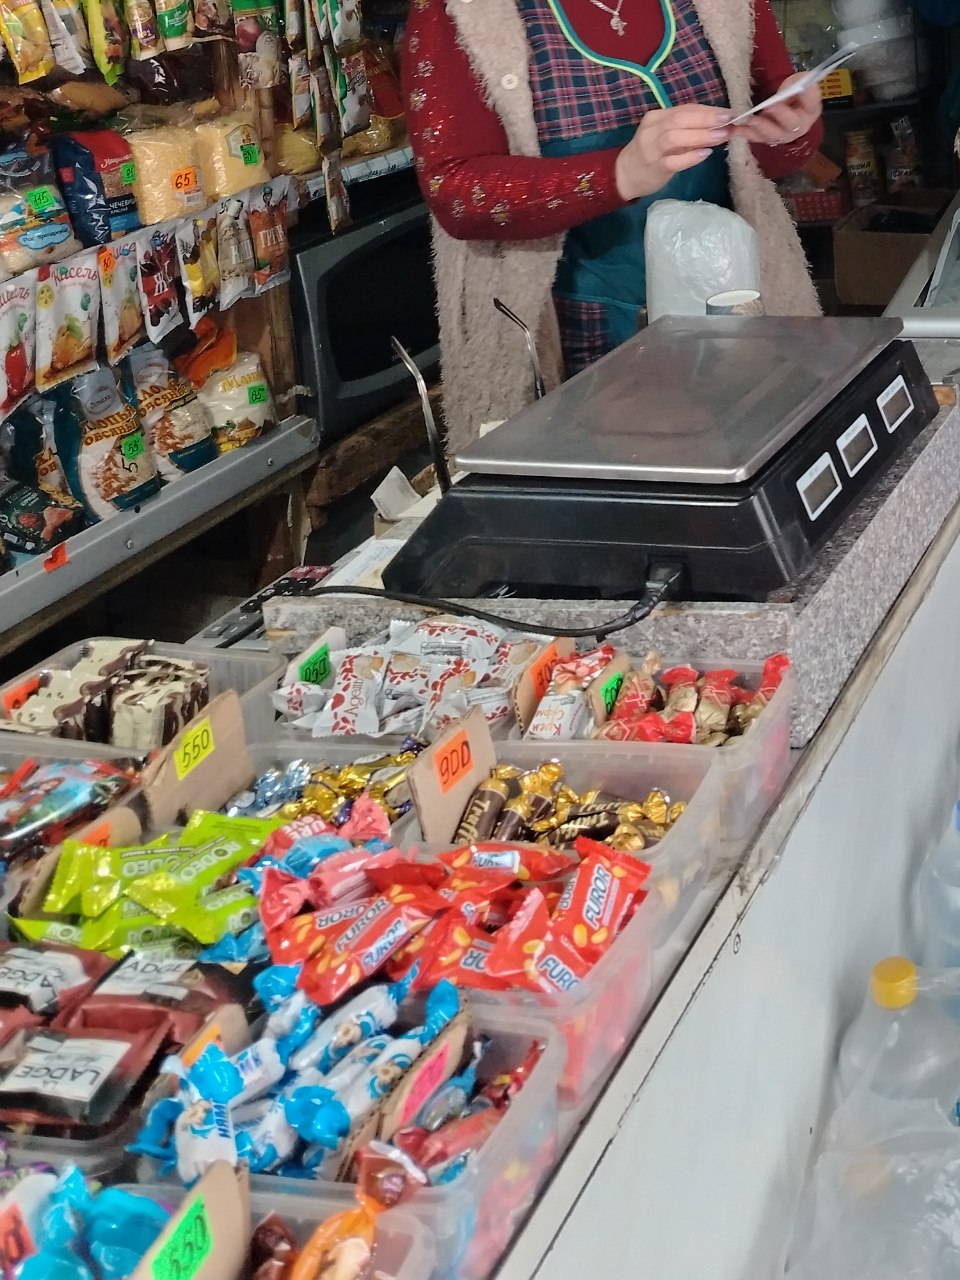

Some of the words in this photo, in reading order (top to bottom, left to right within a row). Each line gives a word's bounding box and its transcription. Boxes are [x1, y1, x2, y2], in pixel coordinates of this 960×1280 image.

[175, 173, 191, 189] 65
[51, 266, 98, 287] Кисель
[182, 728, 211, 769] 550
[439, 739, 471, 785] 900
[583, 863, 610, 930] FUROR
[336, 896, 388, 952] FUROR
[14, 1064, 102, 1087] LADGE
